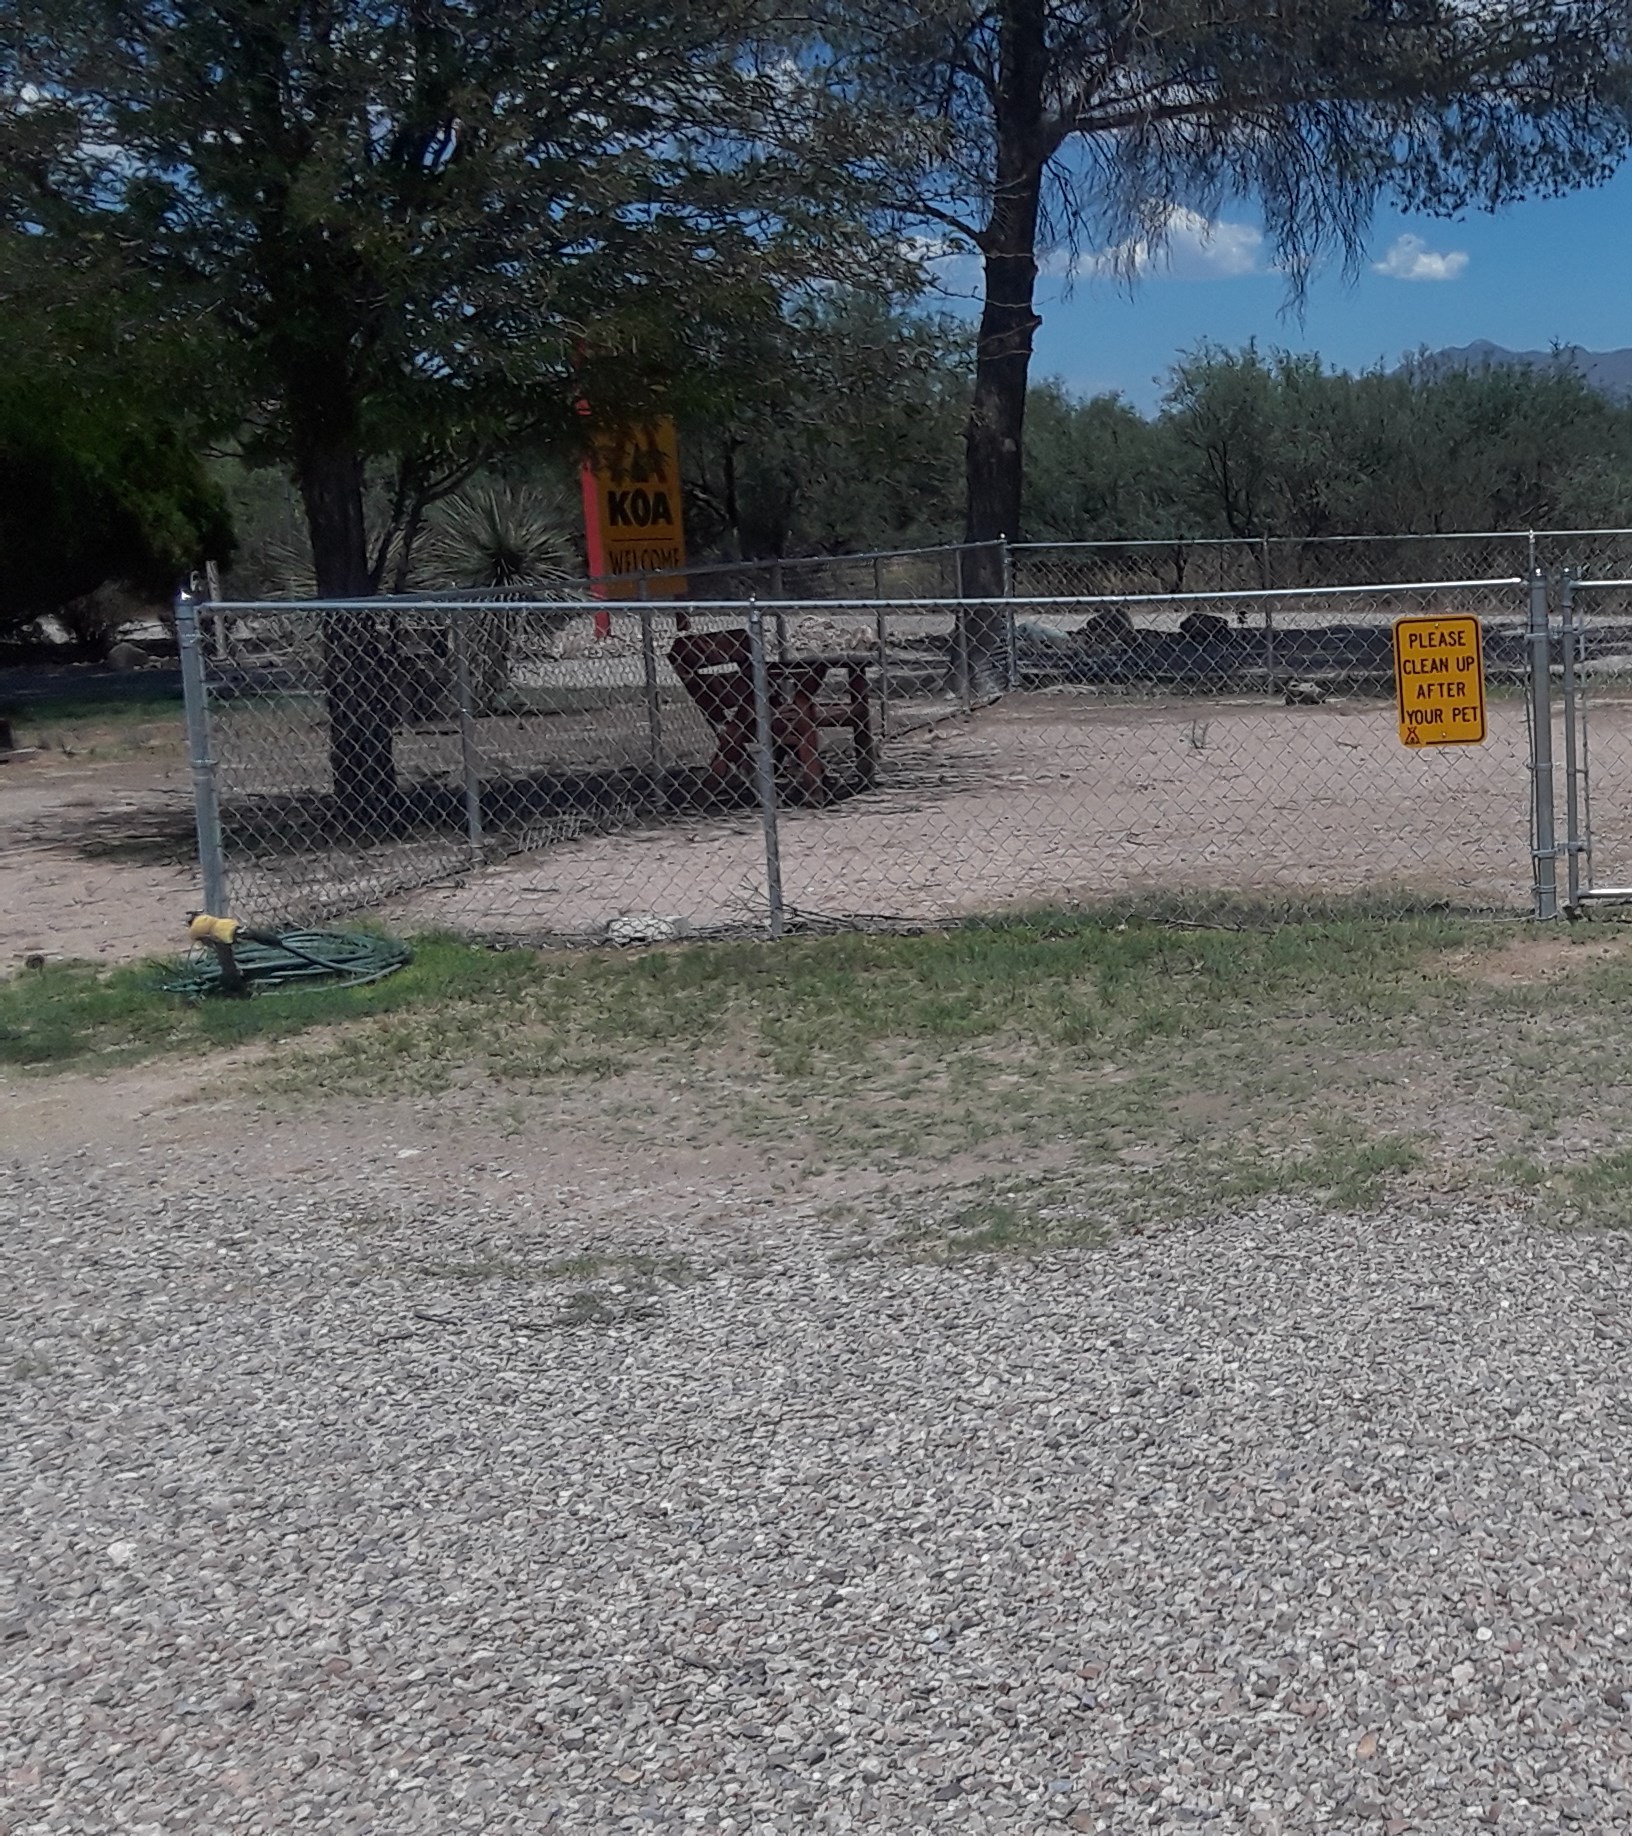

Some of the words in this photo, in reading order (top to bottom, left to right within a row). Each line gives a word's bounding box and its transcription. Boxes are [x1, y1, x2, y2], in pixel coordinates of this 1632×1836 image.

[607, 488, 674, 528] KOA
[608, 548, 680, 575] WELCOME
[1408, 630, 1467, 649] PLEASE
[1403, 656, 1449, 675] CLEAN
[1456, 656, 1475, 672] UP
[1416, 681, 1466, 699] AFTER
[1406, 708, 1443, 725] YOUR
[1452, 706, 1478, 722] PET
